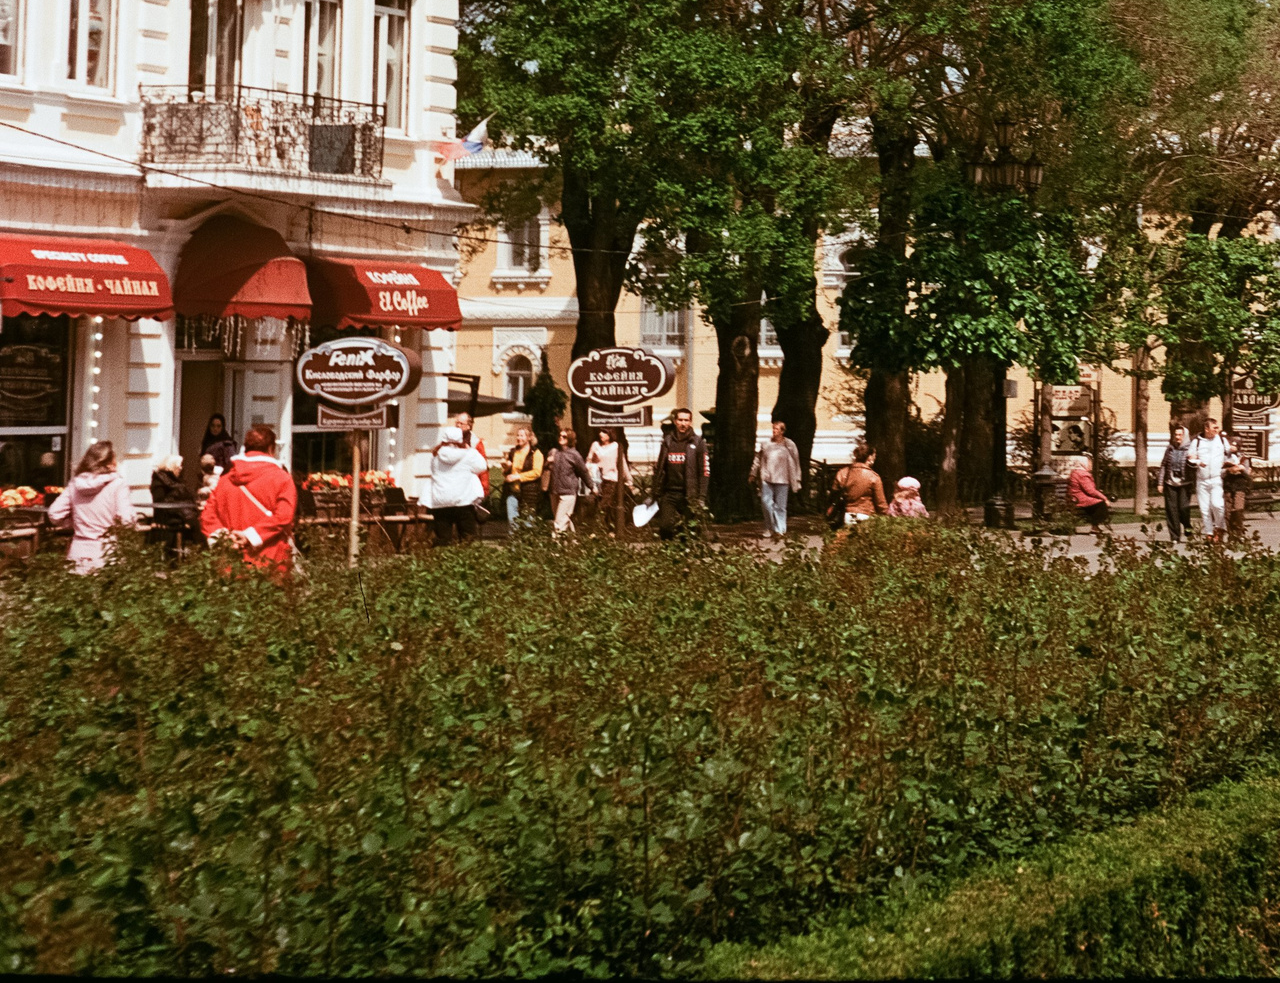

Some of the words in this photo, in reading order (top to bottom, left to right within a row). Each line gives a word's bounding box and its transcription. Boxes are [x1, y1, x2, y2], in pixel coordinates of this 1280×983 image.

[26, 274, 94, 294] КОФЕЙНЯ
[103, 277, 159, 296] ЧАЙНАЯ
[365, 270, 420, 286] КОФЕЙНЯ
[379, 291, 393, 311] El
[393, 290, 429, 316] Coffee
[589, 371, 644, 381] КОФЕЙНЯ
[593, 385, 639, 396] ЧАЙНАЯ
